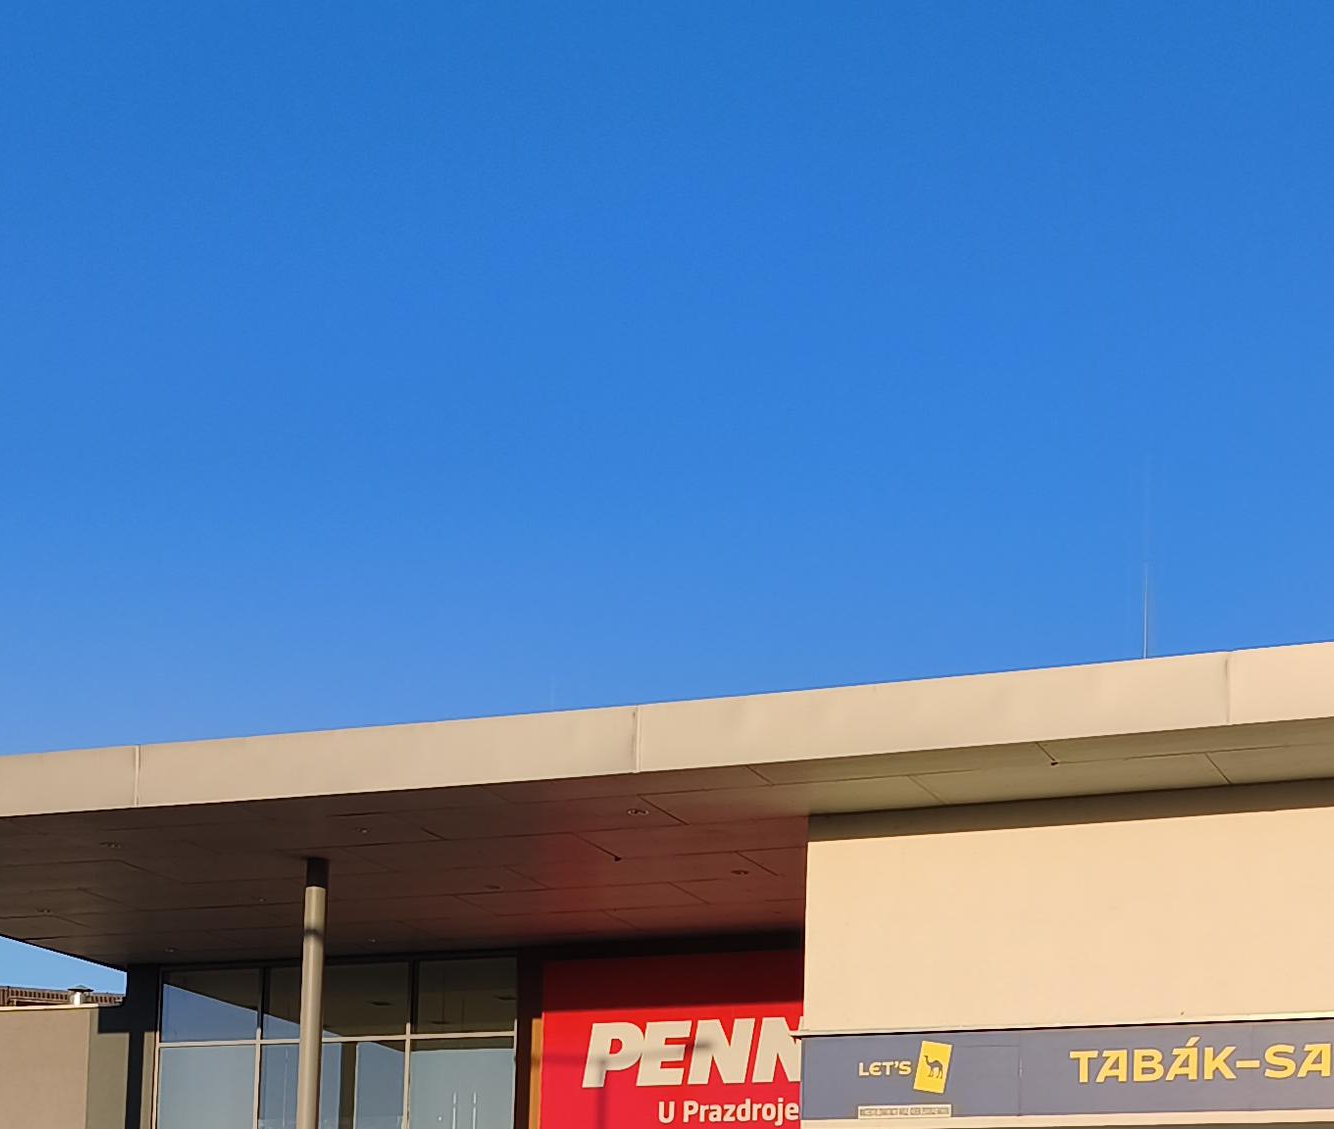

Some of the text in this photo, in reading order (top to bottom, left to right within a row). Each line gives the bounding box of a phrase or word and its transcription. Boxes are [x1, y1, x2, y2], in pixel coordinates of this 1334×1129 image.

[582, 1016, 803, 1088] PENN
[858, 1060, 912, 1076] LET'S
[658, 1097, 800, 1126] U Prazdroje
